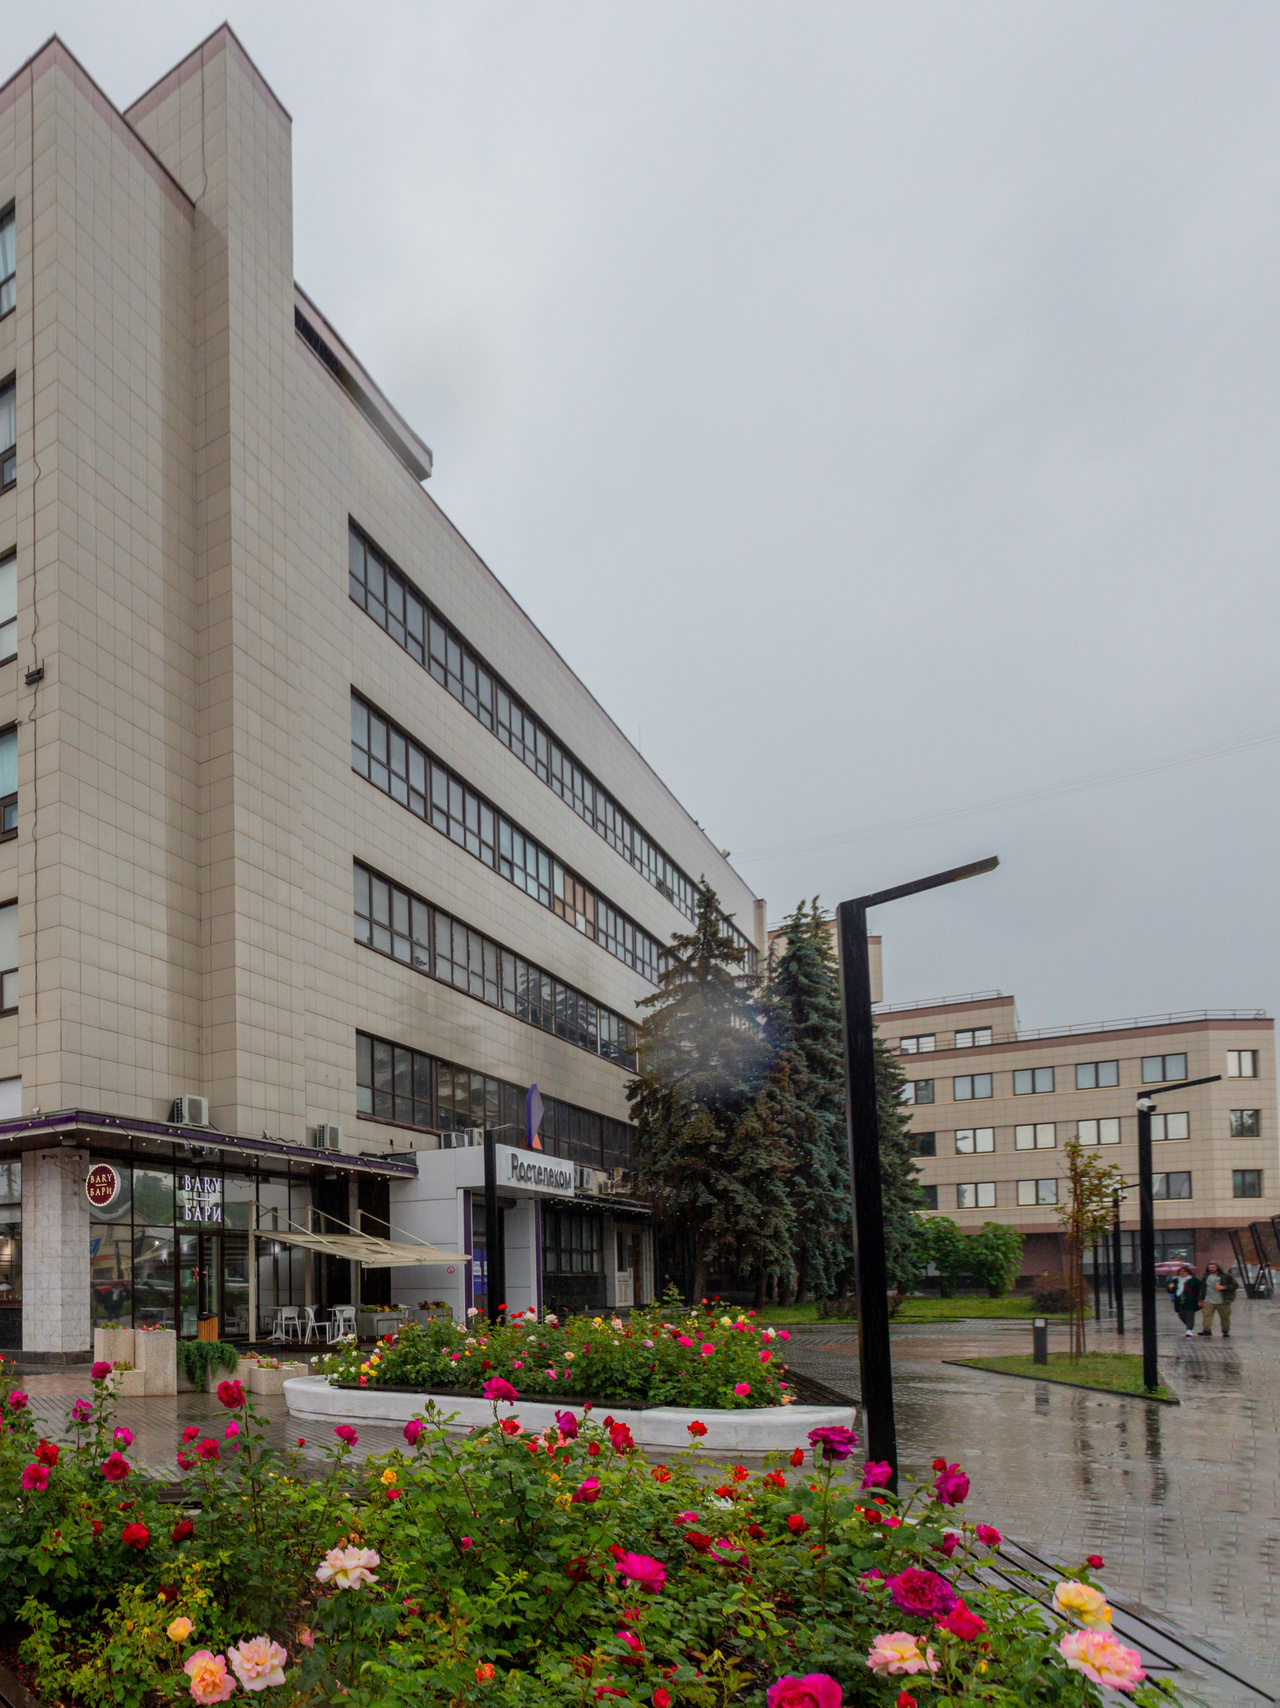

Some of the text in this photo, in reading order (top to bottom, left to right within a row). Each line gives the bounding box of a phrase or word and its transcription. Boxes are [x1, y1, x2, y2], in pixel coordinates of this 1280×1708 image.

[90, 1174, 113, 1184] BARY
[511, 1153, 572, 1189] Ростелеком
[90, 1187, 113, 1197] БАРИ
[184, 1175, 221, 1193] BARY
[184, 1205, 222, 1222] БАРИ
